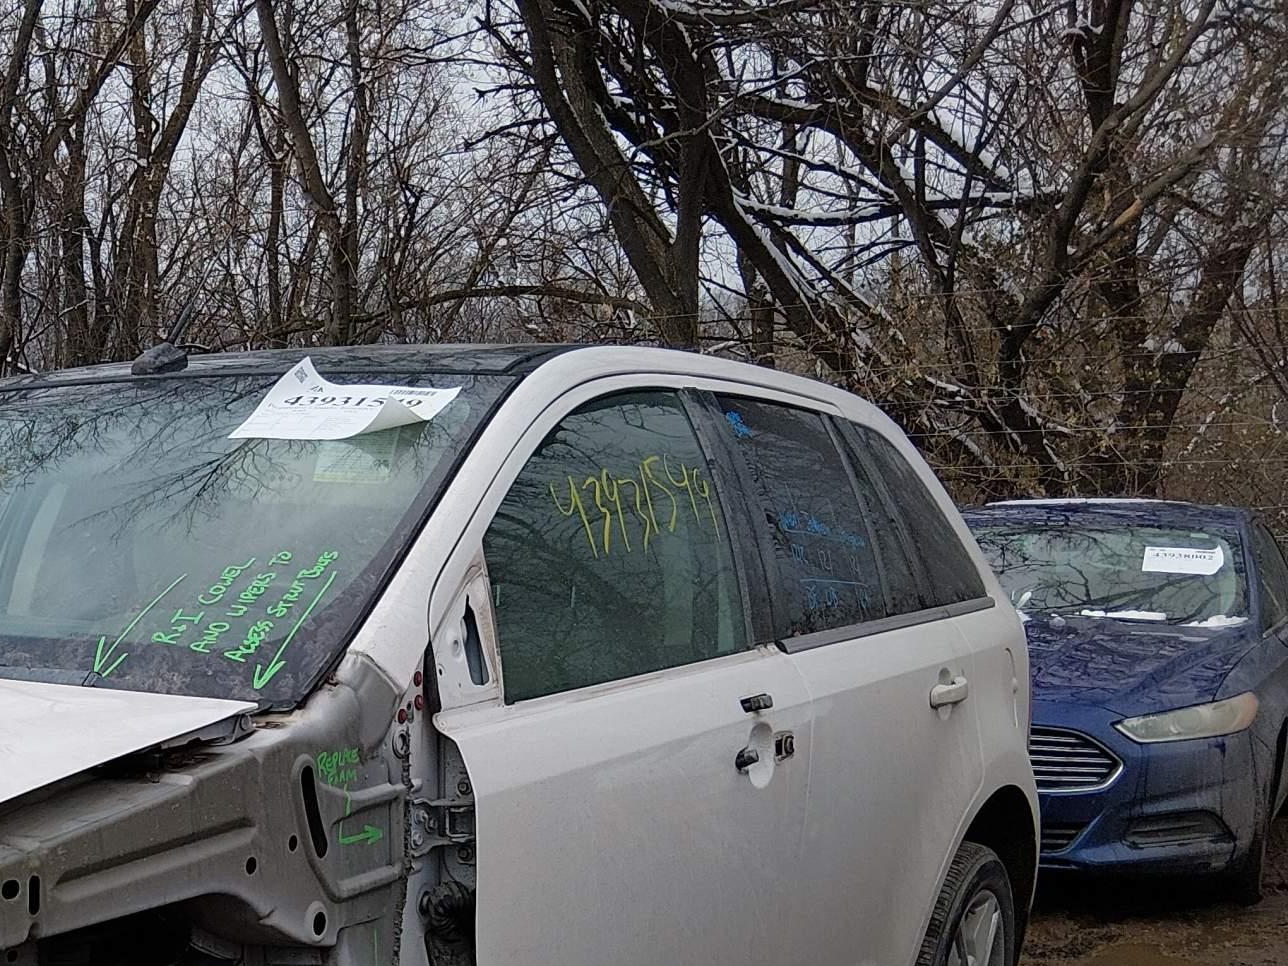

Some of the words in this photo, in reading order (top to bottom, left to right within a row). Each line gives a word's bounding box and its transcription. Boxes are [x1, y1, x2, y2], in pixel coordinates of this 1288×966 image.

[226, 572, 276, 617] WIPERS
[268, 551, 292, 566] TO
[267, 580, 305, 617] STRUT
